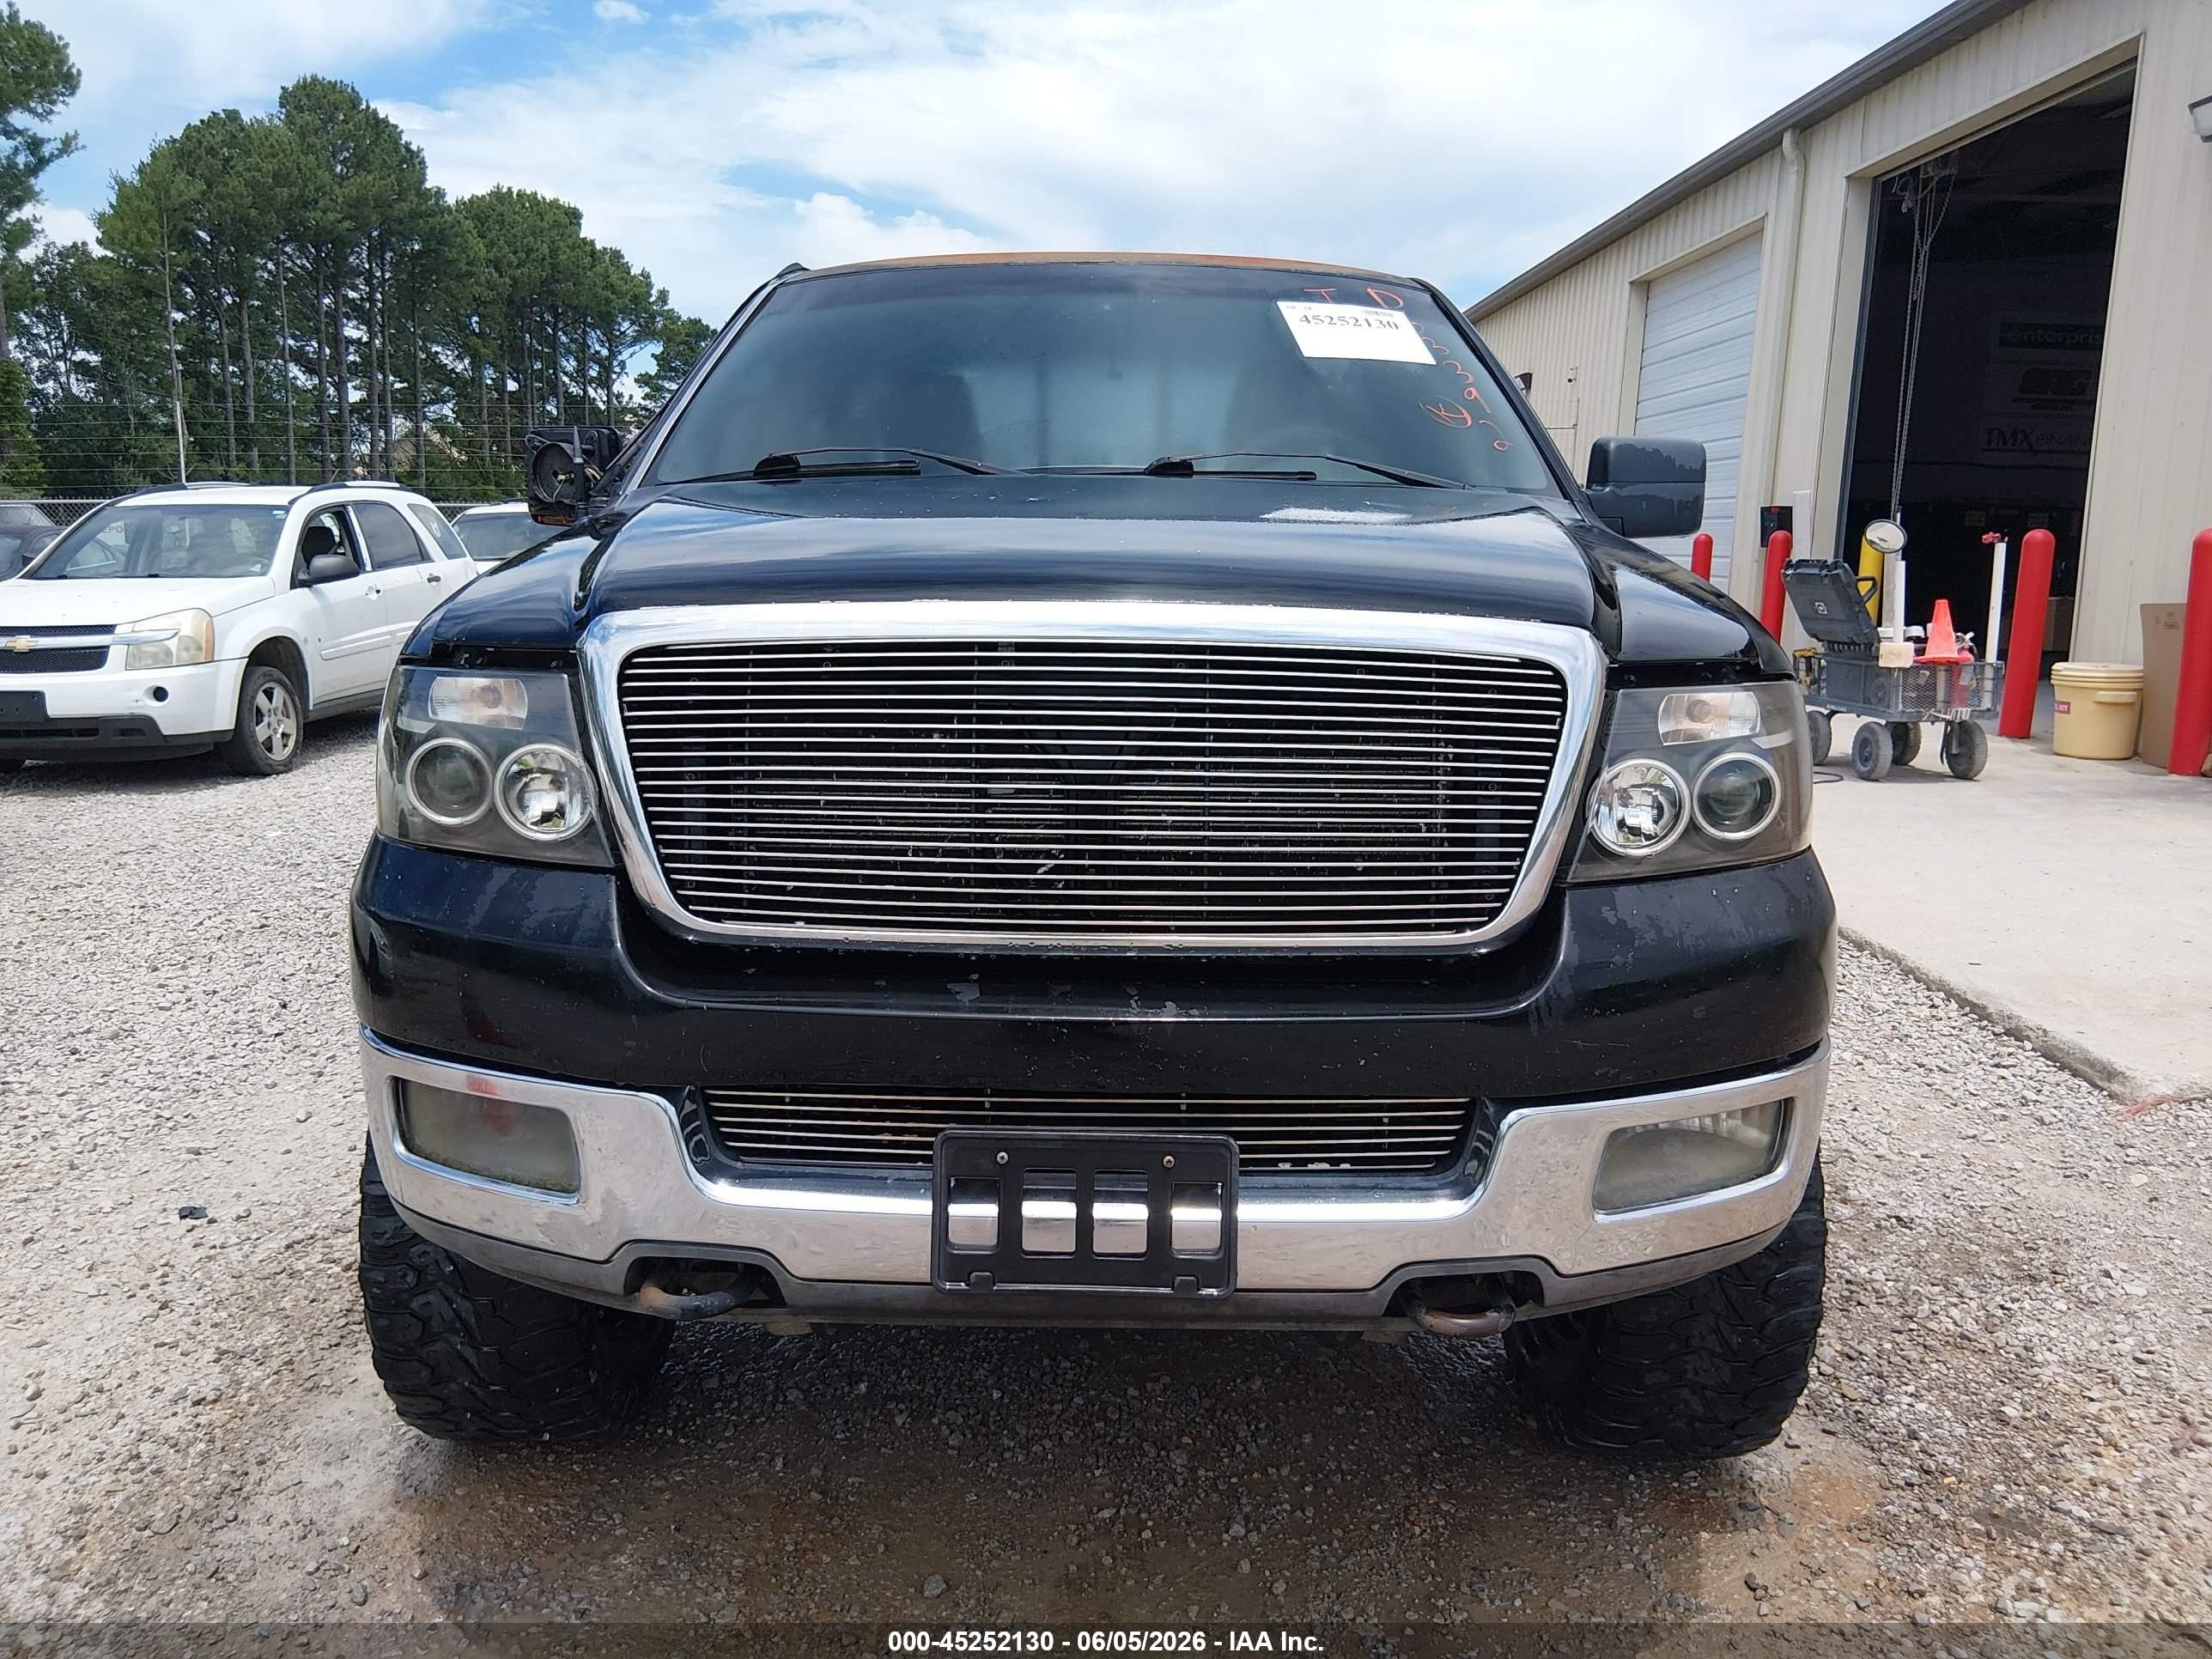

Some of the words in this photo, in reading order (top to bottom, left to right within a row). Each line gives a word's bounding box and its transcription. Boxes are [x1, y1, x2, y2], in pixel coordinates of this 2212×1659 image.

[1366, 288, 1405, 308] D
[1298, 314, 1400, 331] 45252130
[2008, 329, 2104, 347] enterpris
[2036, 433, 2089, 447] FINAN
